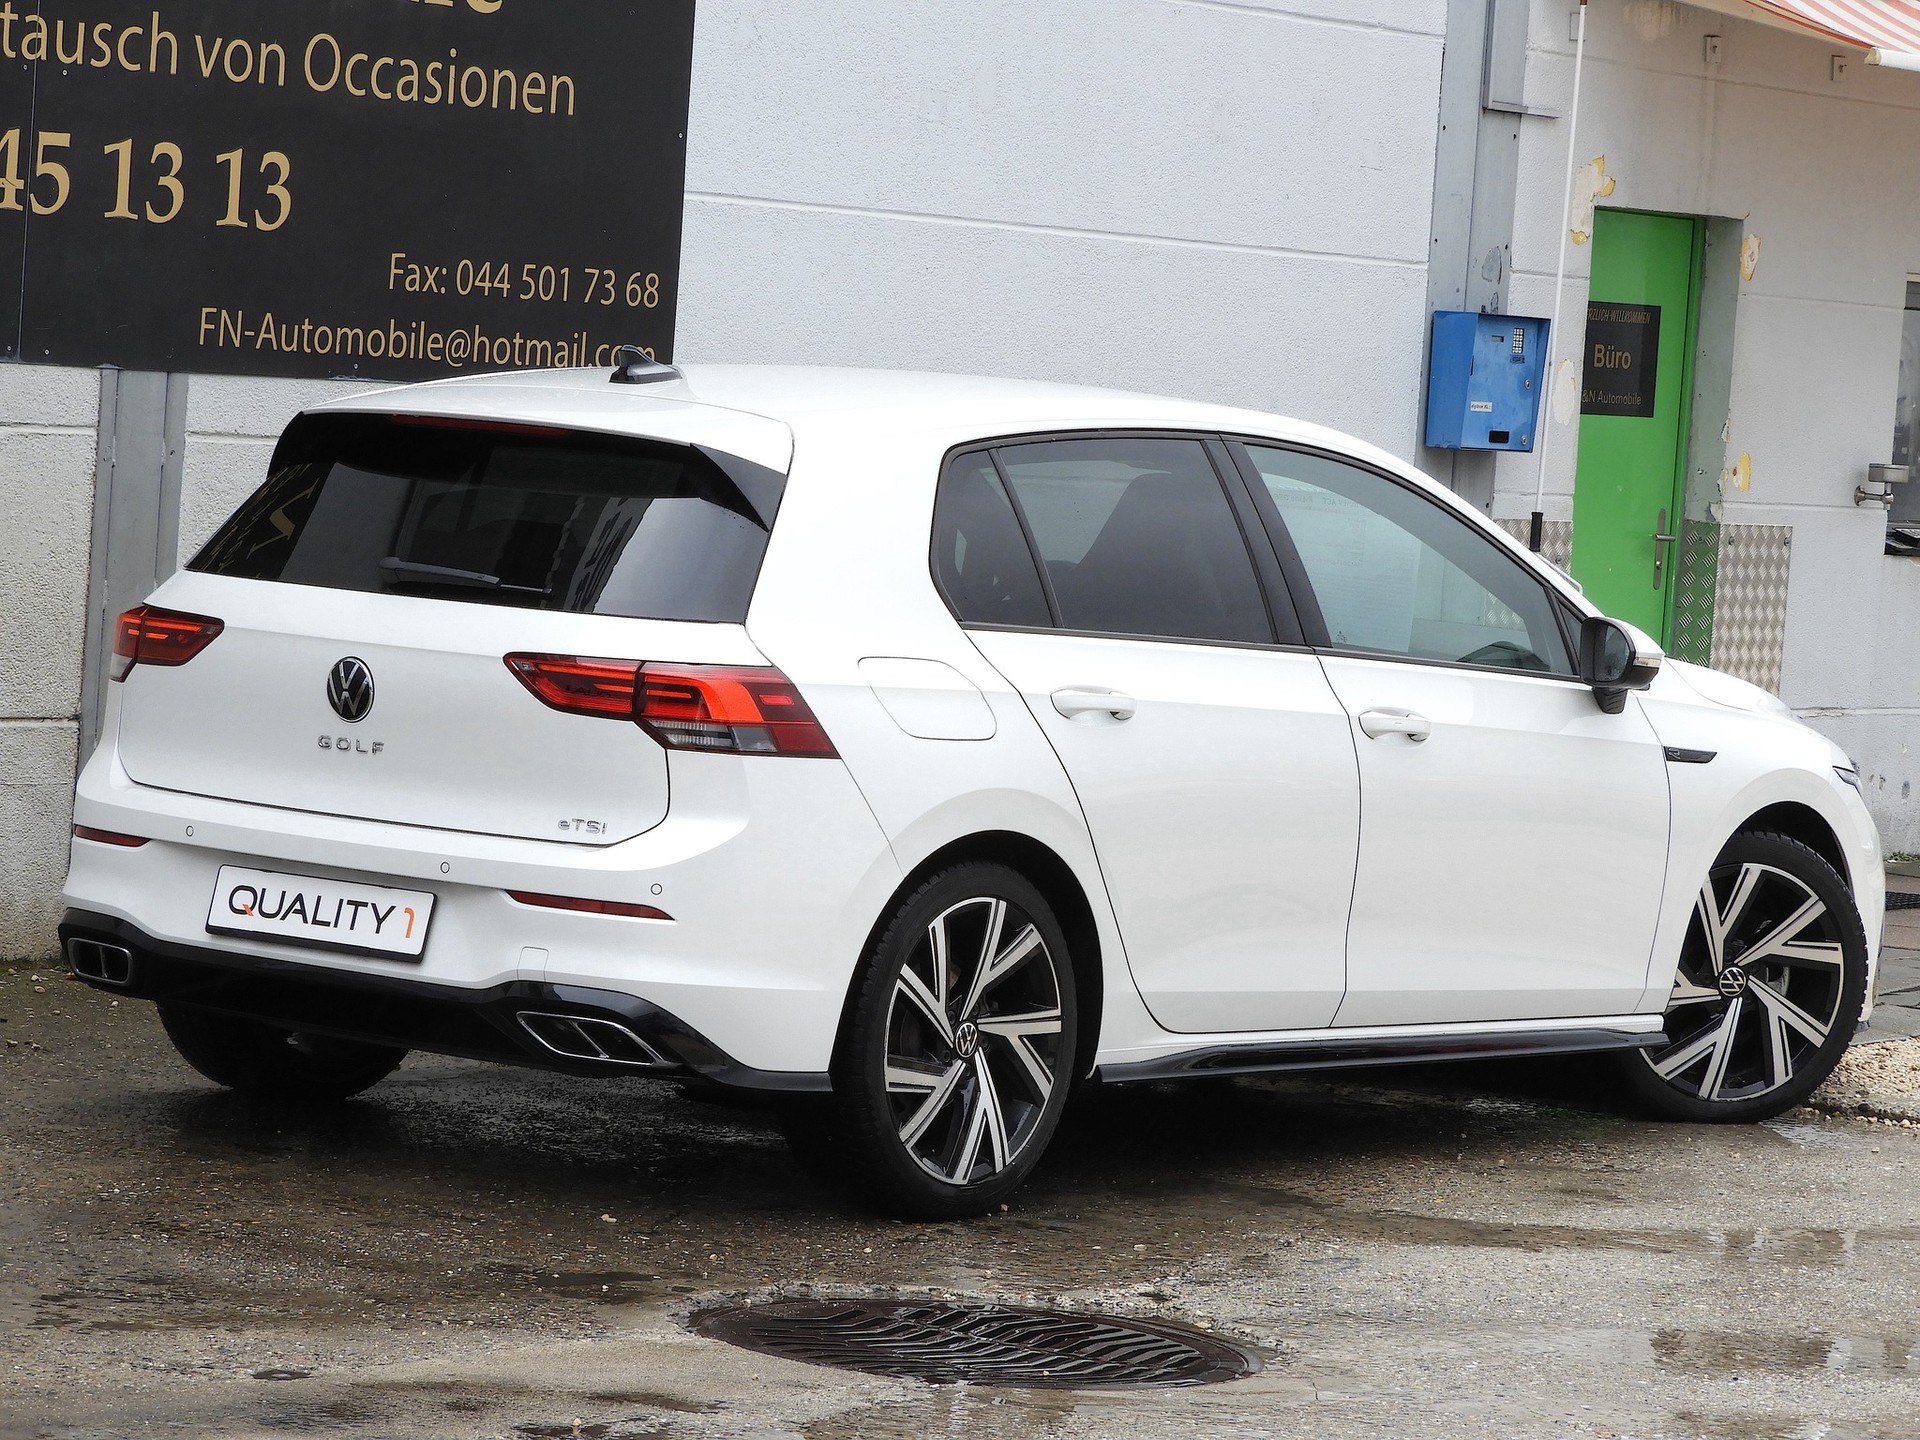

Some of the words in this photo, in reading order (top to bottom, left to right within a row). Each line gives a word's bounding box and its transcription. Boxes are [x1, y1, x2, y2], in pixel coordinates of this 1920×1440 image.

[0, 1, 178, 75] tausch
[194, 34, 287, 87] von
[303, 32, 576, 116] Occasionen
[103, 138, 185, 224] 13
[215, 147, 292, 231] 13
[388, 252, 447, 295] Fax:
[455, 259, 511, 299] 044
[519, 263, 569, 302] 501
[583, 267, 617, 306] 73
[625, 272, 660, 309] 68
[199, 306, 656, 368] FN-Automobile@hotmail.c
[1593, 343, 1632, 370] Büro
[1597, 390, 1642, 406] Automobile
[317, 734, 385, 755] GOLF
[557, 817, 608, 835] eTSI
[228, 885, 397, 935] QUALITY
[403, 906, 416, 939] 1
